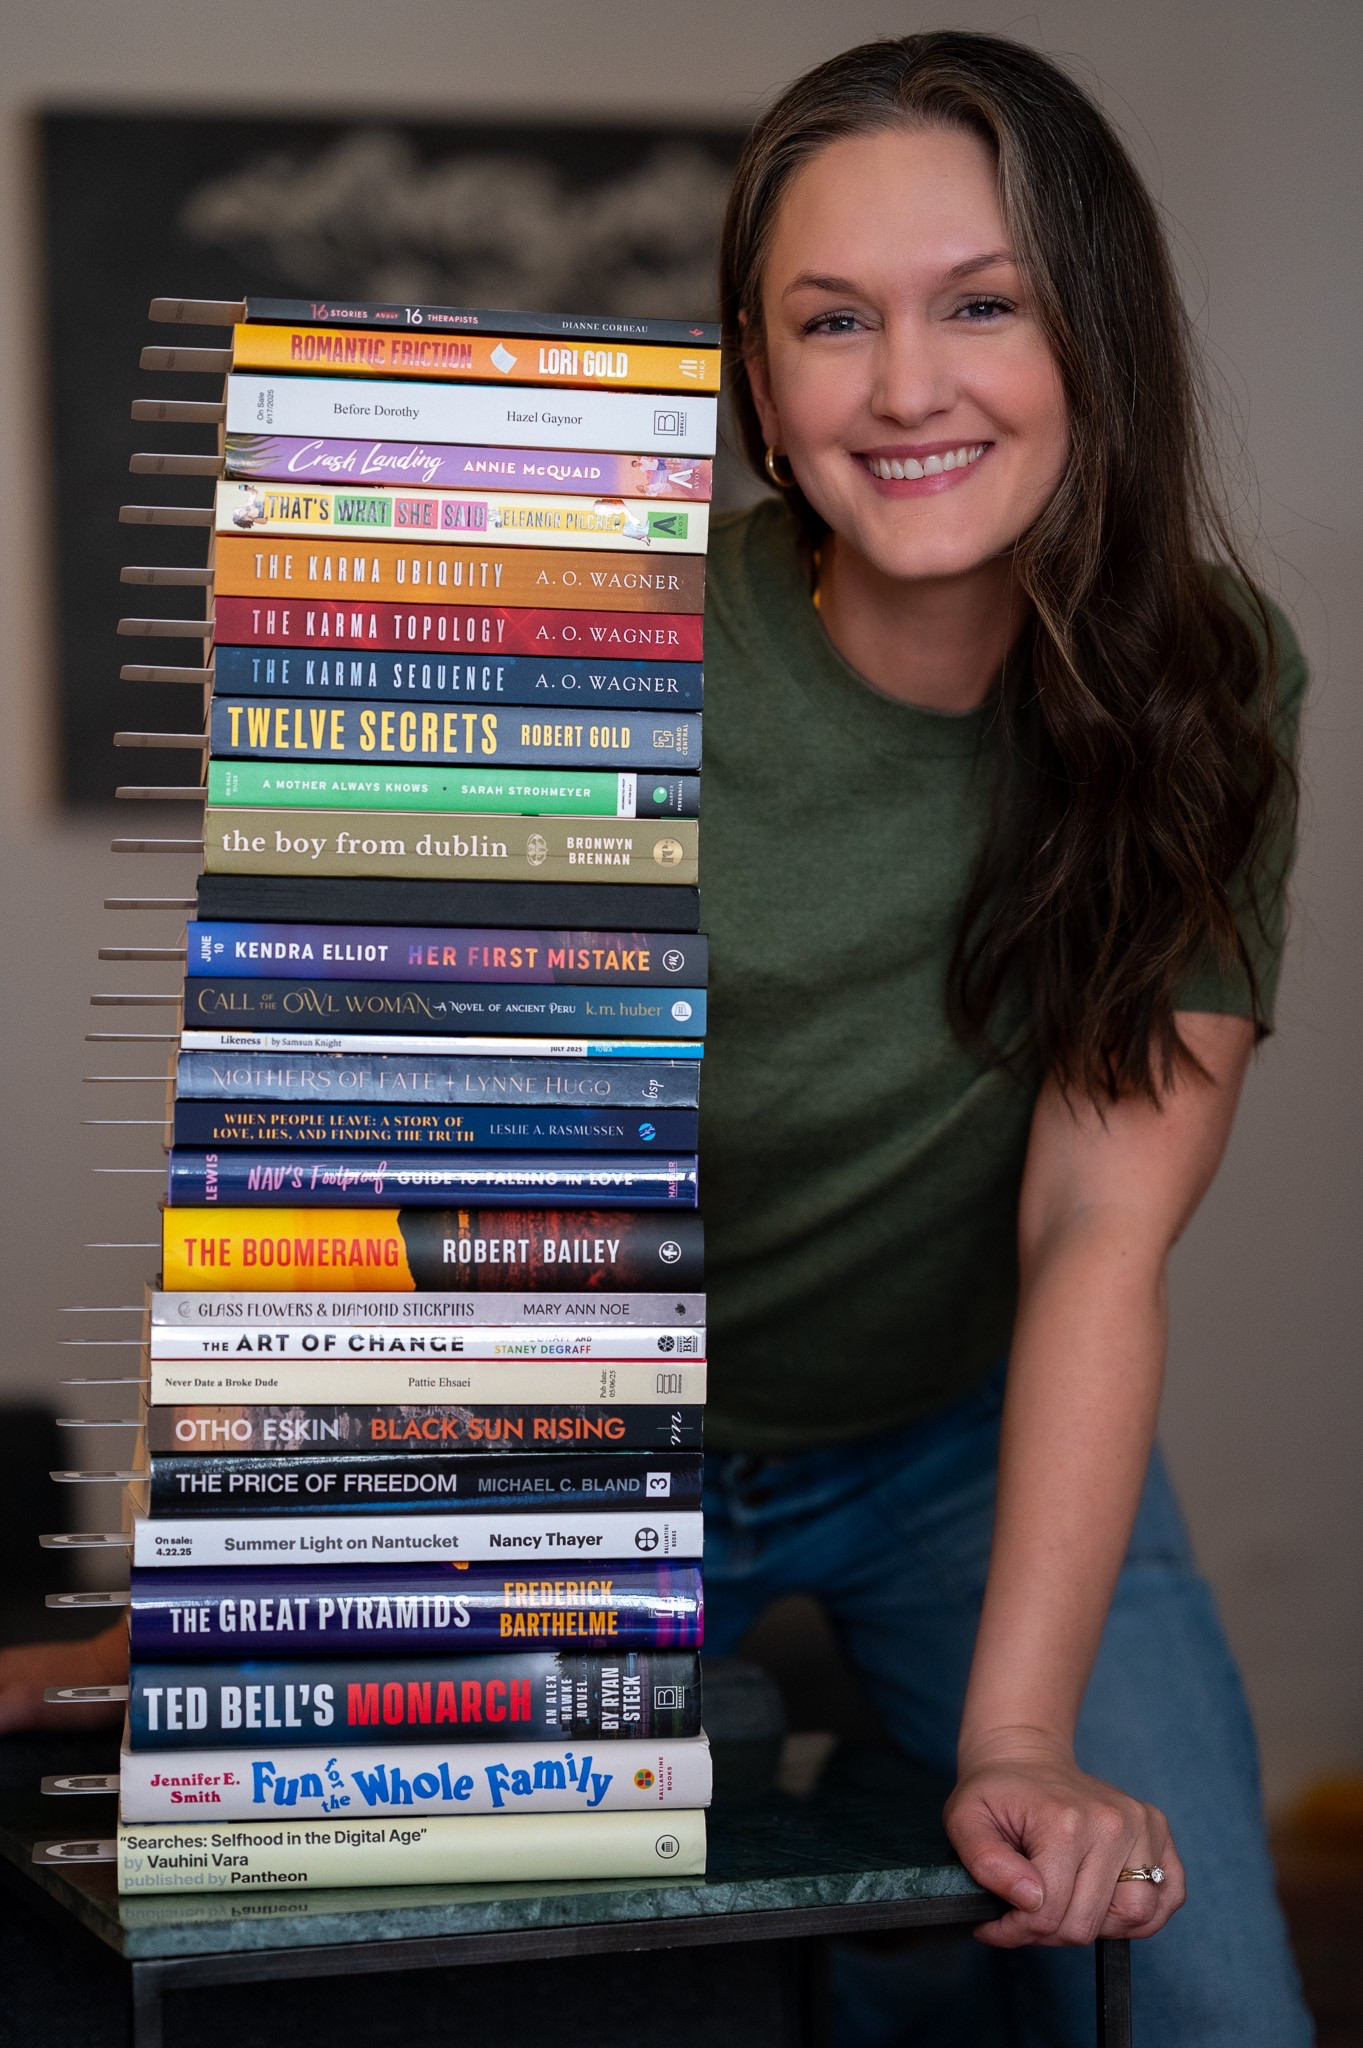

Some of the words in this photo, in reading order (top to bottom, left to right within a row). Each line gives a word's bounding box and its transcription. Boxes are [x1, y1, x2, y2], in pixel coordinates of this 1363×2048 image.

[562, 321, 600, 332] DIANNE
[602, 324, 648, 334] CORBEAU
[291, 334, 386, 365] ROMANTIC
[392, 340, 472, 369] FRICTION
[539, 348, 578, 375] LORI
[582, 350, 628, 378] GOLD
[257, 412, 264, 420] On
[334, 402, 370, 418] Before
[374, 404, 420, 422] Dorothy
[506, 410, 542, 424] Hazel
[544, 412, 582, 428] Gaynor
[288, 440, 356, 474] Crash
[360, 442, 446, 476] Landing
[464, 460, 516, 475] ANNIE
[521, 463, 600, 480] McQUAID
[269, 495, 329, 519] THAT'S
[338, 500, 388, 524] WHAT
[398, 503, 432, 526] SHE
[444, 504, 485, 528] SAID
[255, 553, 293, 580] THE
[309, 555, 380, 583] KARMA
[396, 558, 504, 588] UBIQUITY
[252, 610, 290, 636] THE
[306, 612, 378, 639] KARMA
[394, 614, 506, 644] TOPOLOGY
[252, 658, 290, 684] THE
[306, 660, 378, 687] KARMA
[394, 663, 505, 692] SEQUENCE
[228, 706, 345, 750] TWELVE
[360, 710, 498, 754] SECRETS
[521, 725, 584, 747] ROBERT
[590, 727, 630, 748] GOLD
[263, 780, 270, 790] A
[276, 780, 328, 790] MOTHER
[332, 782, 380, 792] ALWAYS
[386, 783, 428, 793] KNOWS
[461, 784, 504, 795] SARAH
[508, 786, 591, 798] STROHMEYER
[222, 830, 266, 851] the
[275, 831, 326, 856] boy
[336, 832, 406, 855] from
[416, 832, 508, 858] dublin
[566, 837, 633, 852] BRONWYN
[569, 852, 630, 865] BRENNAN
[202, 936, 212, 962] JUNE
[215, 943, 223, 954] 10
[235, 941, 314, 960] KENDRA
[324, 944, 388, 962] ELLIOT
[408, 945, 456, 966] HER
[468, 947, 538, 968] FIRST
[548, 949, 650, 971] MISTAKE
[198, 988, 254, 1015] CALL
[283, 987, 340, 1016] OWL
[346, 992, 446, 1018] WOMAN
[221, 1036, 260, 1046] Likeness
[272, 1038, 280, 1047] by
[282, 1038, 312, 1046] Samsun
[314, 1038, 342, 1048] Knight
[224, 1114, 266, 1124] WHEN
[271, 1114, 324, 1126] PEOPLE
[330, 1114, 376, 1126] LEAVE:
[380, 1116, 390, 1126] A
[394, 1116, 438, 1127] STORY
[445, 1116, 464, 1127] OF
[214, 1128, 254, 1140] LOVE,
[259, 1128, 292, 1140] LIES,
[297, 1129, 326, 1140] AND
[331, 1130, 391, 1141] FINDING
[396, 1130, 422, 1141] THE
[428, 1131, 474, 1142] TRUTH
[205, 1154, 218, 1200] LEWIS
[184, 1238, 236, 1267] THE
[242, 1238, 398, 1267] BOOMERANG
[443, 1239, 528, 1265] ROBERT
[543, 1239, 620, 1264] BAILEY
[198, 1302, 244, 1318] GLASS
[248, 1302, 314, 1318] FLOWERS
[317, 1302, 327, 1317] &
[331, 1302, 399, 1318] DIAMOND
[402, 1302, 474, 1318] STICKPINS
[524, 1302, 560, 1316] MARY
[565, 1302, 594, 1315] ANN
[599, 1302, 630, 1315] NOE
[494, 1344, 536, 1354] STANEY
[541, 1344, 591, 1354] DEGRAFF
[165, 1378, 191, 1388] Never
[194, 1378, 214, 1388] Date
[224, 1378, 250, 1388] Broke
[254, 1378, 278, 1388] Dude
[408, 1377, 435, 1388] Pattie
[438, 1377, 470, 1387] Ehsaei
[176, 1419, 252, 1442] OTHO
[262, 1419, 338, 1441] ESKIN
[371, 1418, 459, 1440] BLACK
[468, 1418, 523, 1440] SUN
[534, 1418, 626, 1440] RISING
[176, 1474, 222, 1493] THE
[228, 1474, 298, 1492] PRICE
[305, 1474, 336, 1492] OF
[344, 1474, 456, 1492] FREEDOM
[155, 1536, 168, 1545] On
[172, 1536, 192, 1545] sale:
[224, 1534, 296, 1550] Summer
[300, 1535, 342, 1552] Light
[345, 1540, 366, 1550] on
[372, 1534, 459, 1549] Nantucket
[489, 1533, 541, 1550] Nancy
[546, 1532, 603, 1548] Thayer
[156, 1548, 191, 1556] 4.22.25
[170, 1609, 210, 1634] THE
[219, 1599, 310, 1632] GREAT
[318, 1595, 470, 1631] PYRAMIDS
[500, 1611, 618, 1638] BARTHELME
[546, 1674, 556, 1704] ALEX
[562, 1678, 572, 1720] HAWKE
[577, 1681, 587, 1718] NOVEL
[144, 1687, 208, 1730] TED
[348, 1678, 532, 1725] MONARCH
[546, 1712, 556, 1724] AN
[150, 1774, 220, 1788] Jennifer
[224, 1773, 240, 1785] E.
[252, 1762, 322, 1805] Fun
[325, 1758, 345, 1789] for
[352, 1762, 474, 1806] Whole
[486, 1752, 613, 1808] Family
[170, 1790, 221, 1804] Smith
[322, 1794, 350, 1813] the
[124, 1855, 143, 1872] by
[146, 1853, 208, 1869] Vauhini
[212, 1852, 248, 1867] Vara
[124, 1873, 204, 1889] published
[208, 1872, 226, 1887] by
[230, 1870, 308, 1884] Pantheon
